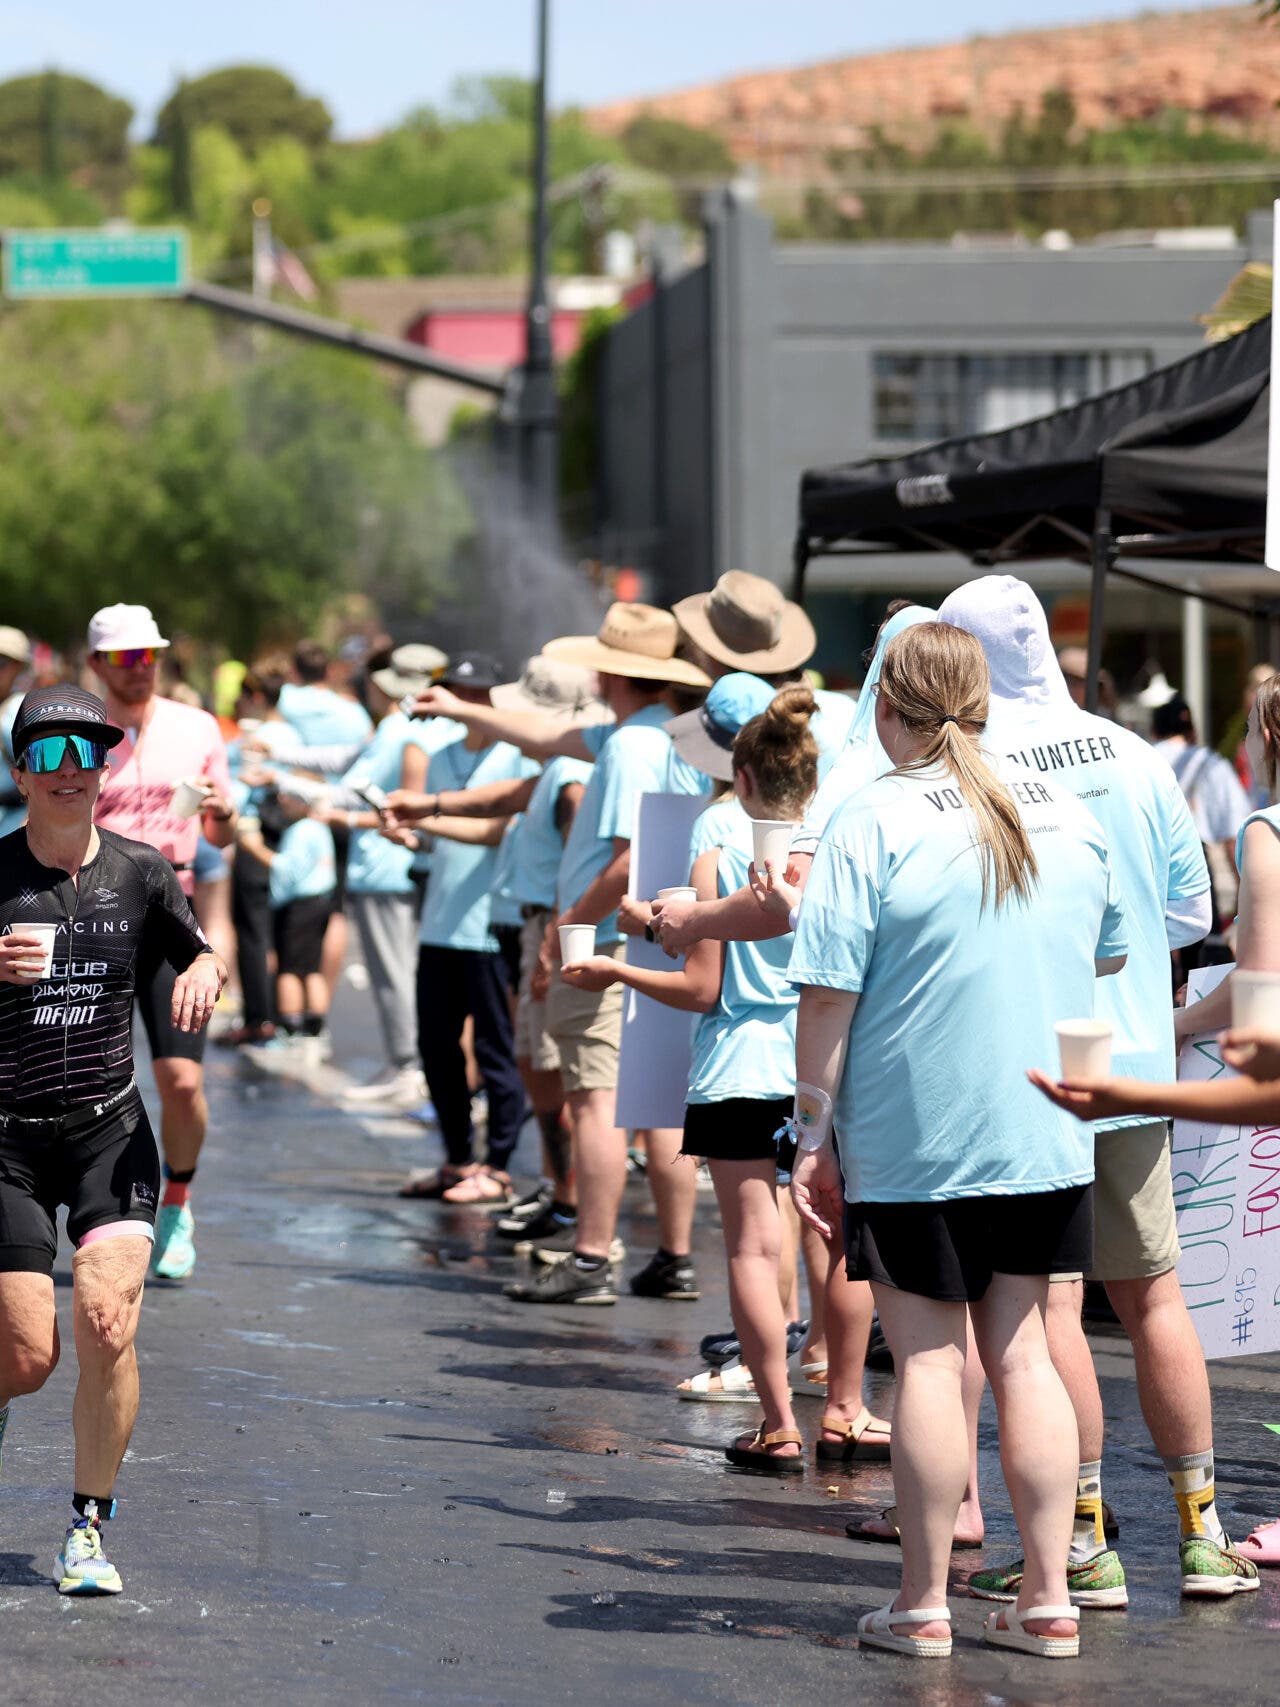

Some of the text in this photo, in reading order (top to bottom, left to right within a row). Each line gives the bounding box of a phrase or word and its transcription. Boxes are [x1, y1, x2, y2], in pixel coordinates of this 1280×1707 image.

[1006, 736, 1116, 772] UNTEER
[924, 782, 1054, 812] VOEER
[1076, 786, 1110, 800] ountain
[1025, 823, 1061, 836] ountain
[56, 920, 129, 935] ACING
[51, 962, 108, 978] UUB
